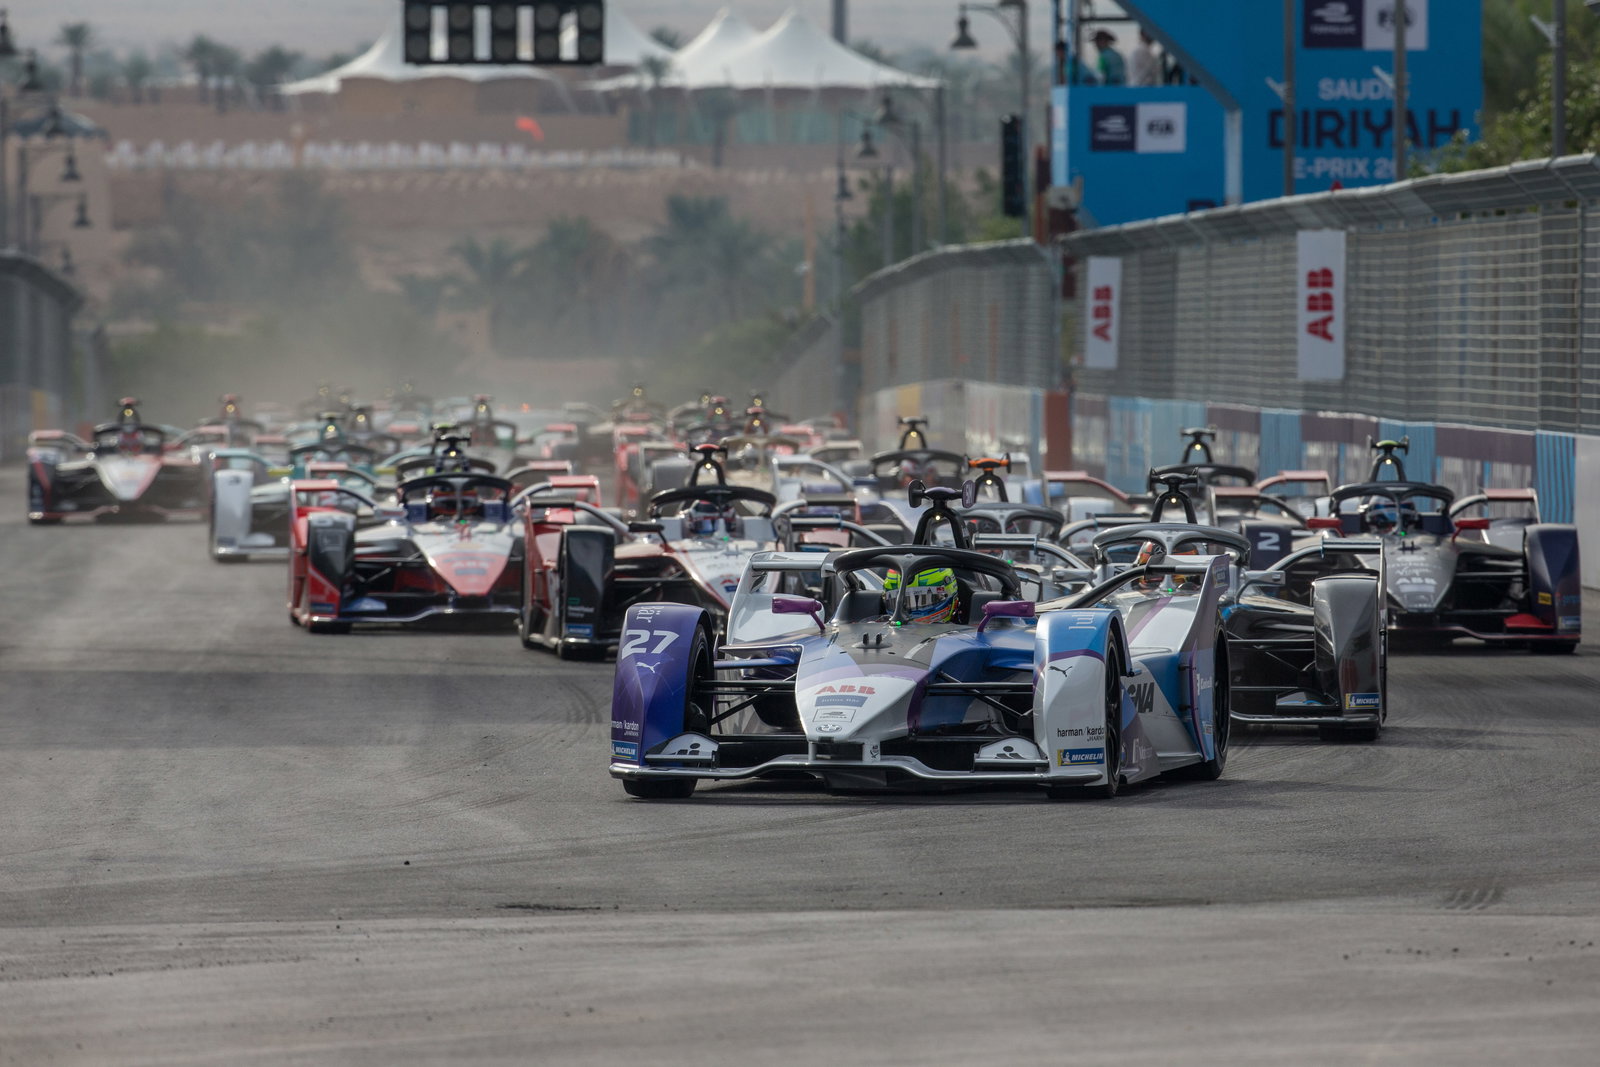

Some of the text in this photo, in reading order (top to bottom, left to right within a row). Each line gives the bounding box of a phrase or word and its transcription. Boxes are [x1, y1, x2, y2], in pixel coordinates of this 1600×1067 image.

[1292, 157, 1370, 179] E-PRIX
[1092, 285, 1112, 343] ABB
[1306, 267, 1334, 343] ABB
[1258, 531, 1280, 551] 2
[621, 629, 680, 660] 27
[814, 685, 876, 695] ABB
[1071, 752, 1104, 761] MICHELIN
